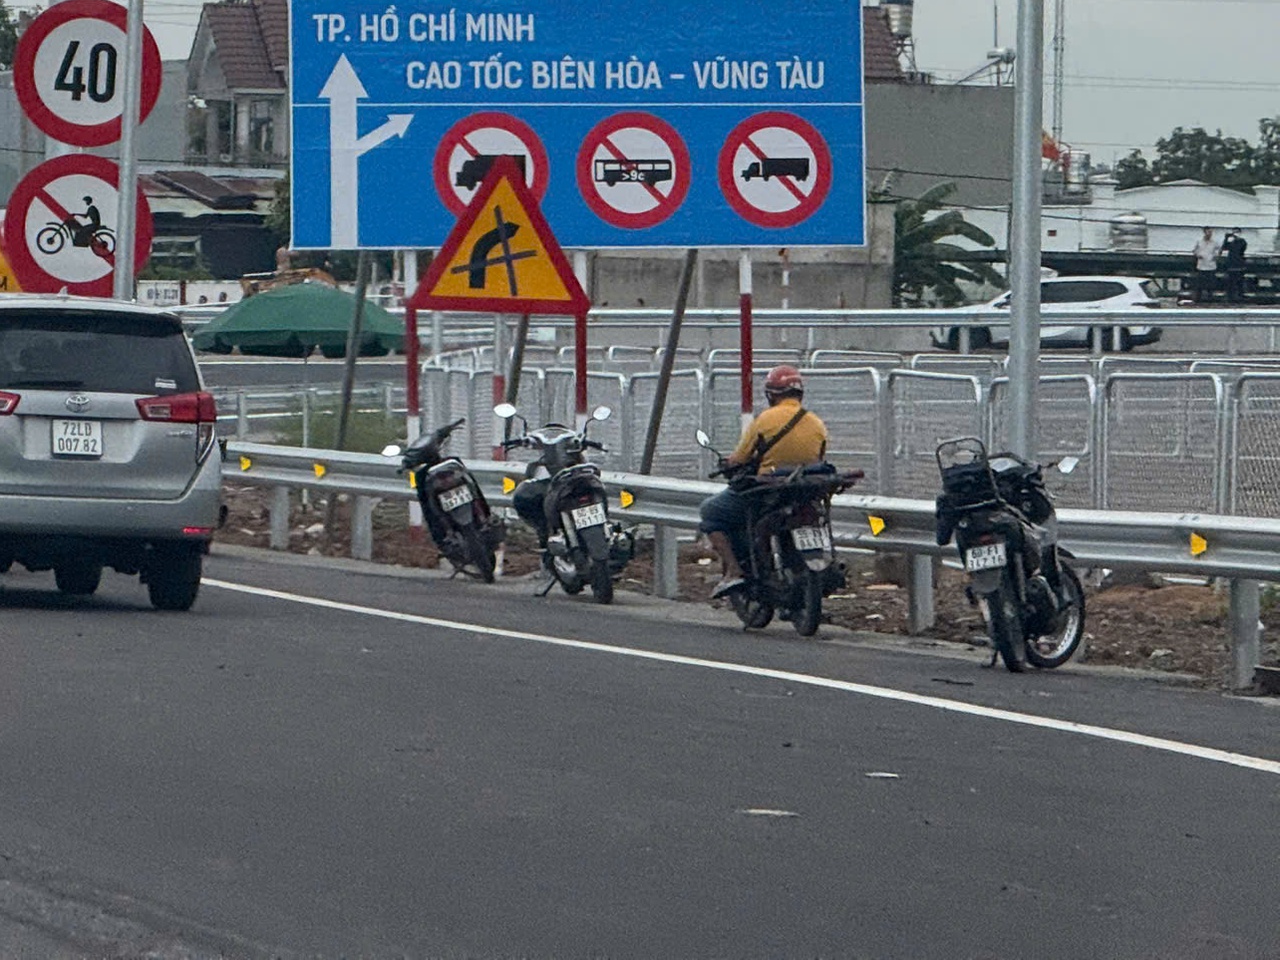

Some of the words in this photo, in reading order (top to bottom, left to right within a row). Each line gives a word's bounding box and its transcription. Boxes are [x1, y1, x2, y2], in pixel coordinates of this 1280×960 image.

[312, 13, 351, 42] TP.
[360, 4, 399, 42] HỒ
[409, 7, 456, 42] CHÍ
[466, 13, 535, 42] MINH
[53, 40, 118, 103] 40
[406, 61, 462, 89] CAO
[468, 52, 522, 89] TỐC
[532, 55, 595, 89] BIÊN
[605, 54, 662, 89] HÒA
[693, 55, 768, 89] VŨNG
[776, 55, 825, 89] TÀU
[58, 437, 98, 453] 007.82
[62, 421, 92, 436] 72LD
